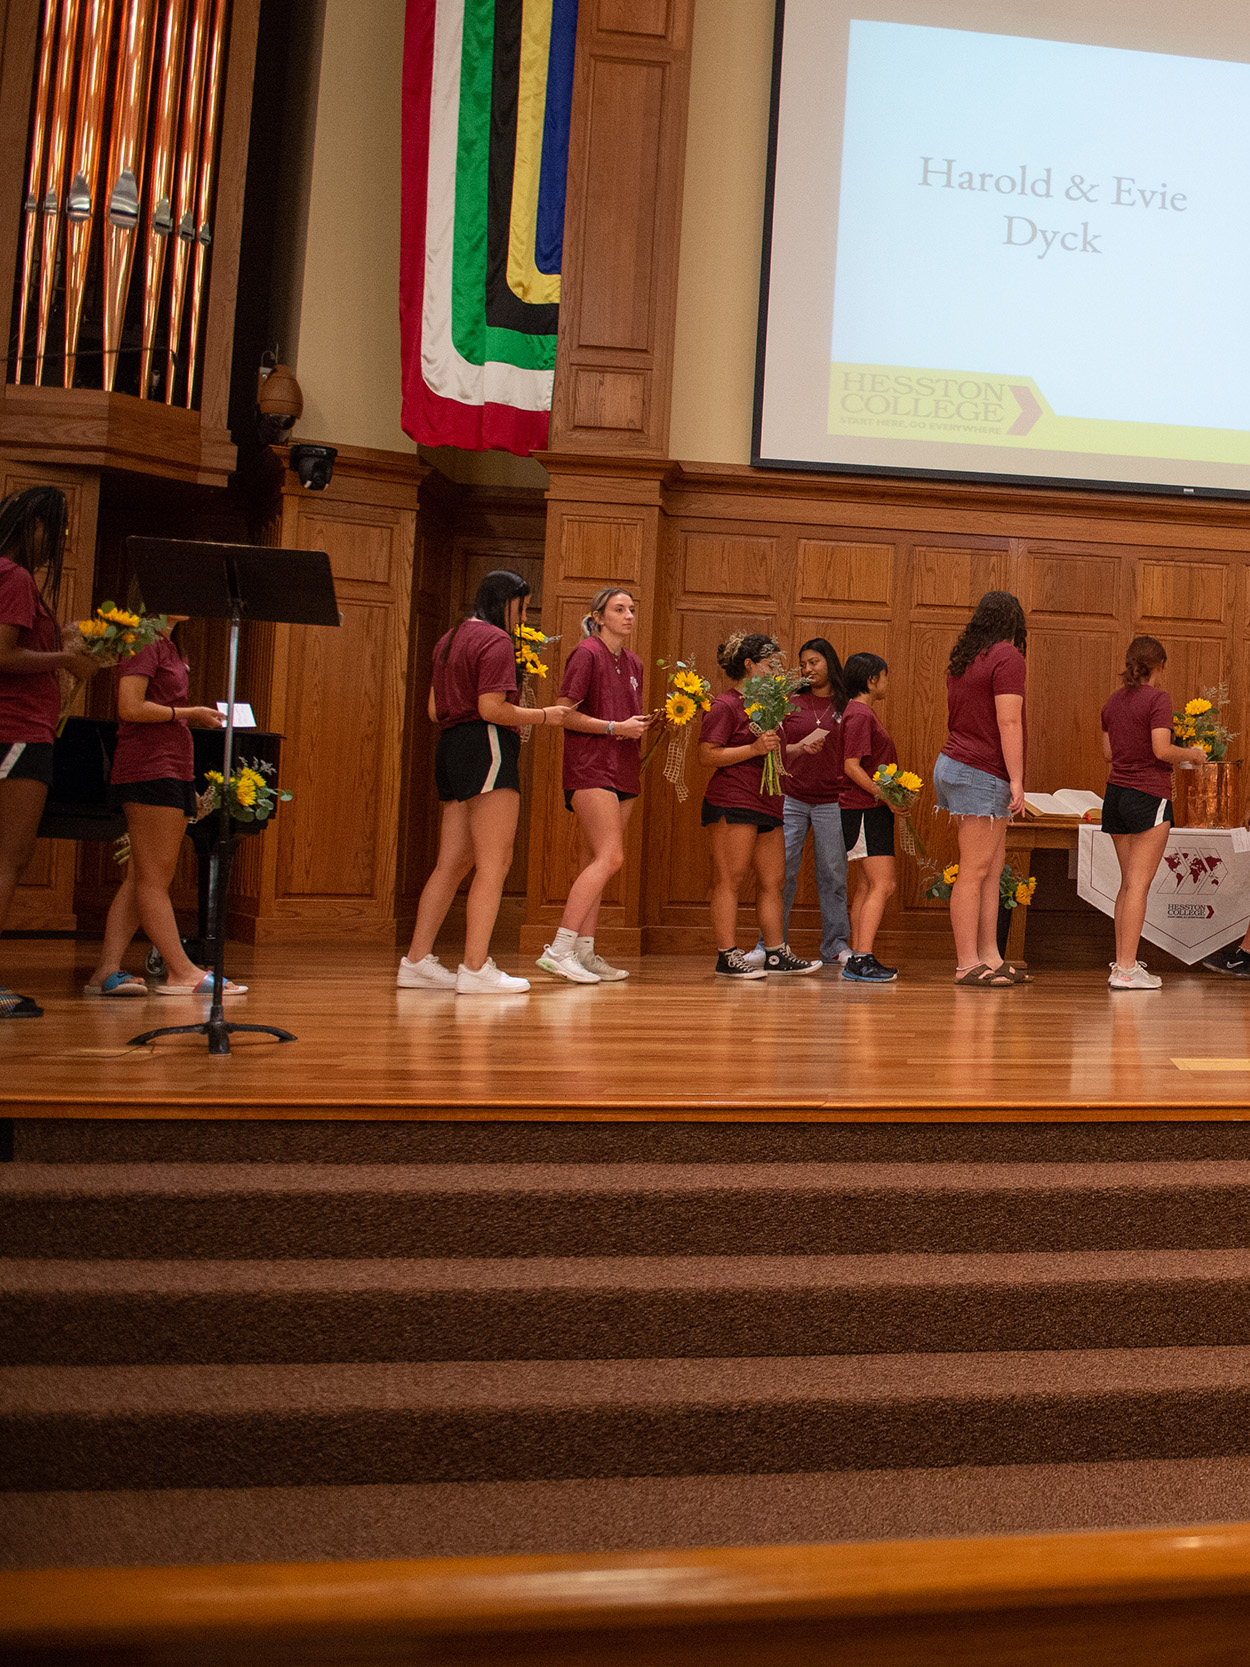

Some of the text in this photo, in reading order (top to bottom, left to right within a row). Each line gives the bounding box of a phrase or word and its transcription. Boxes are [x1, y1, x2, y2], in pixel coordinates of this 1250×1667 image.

[918, 156, 1188, 212] Harold & Evie
[1002, 215, 1103, 260] Dyck
[843, 372, 1005, 402] HESSTON
[841, 393, 1004, 423] COLLEGE
[839, 417, 874, 426] START
[910, 421, 926, 429] GO
[929, 422, 1002, 435] EVERYWHERE
